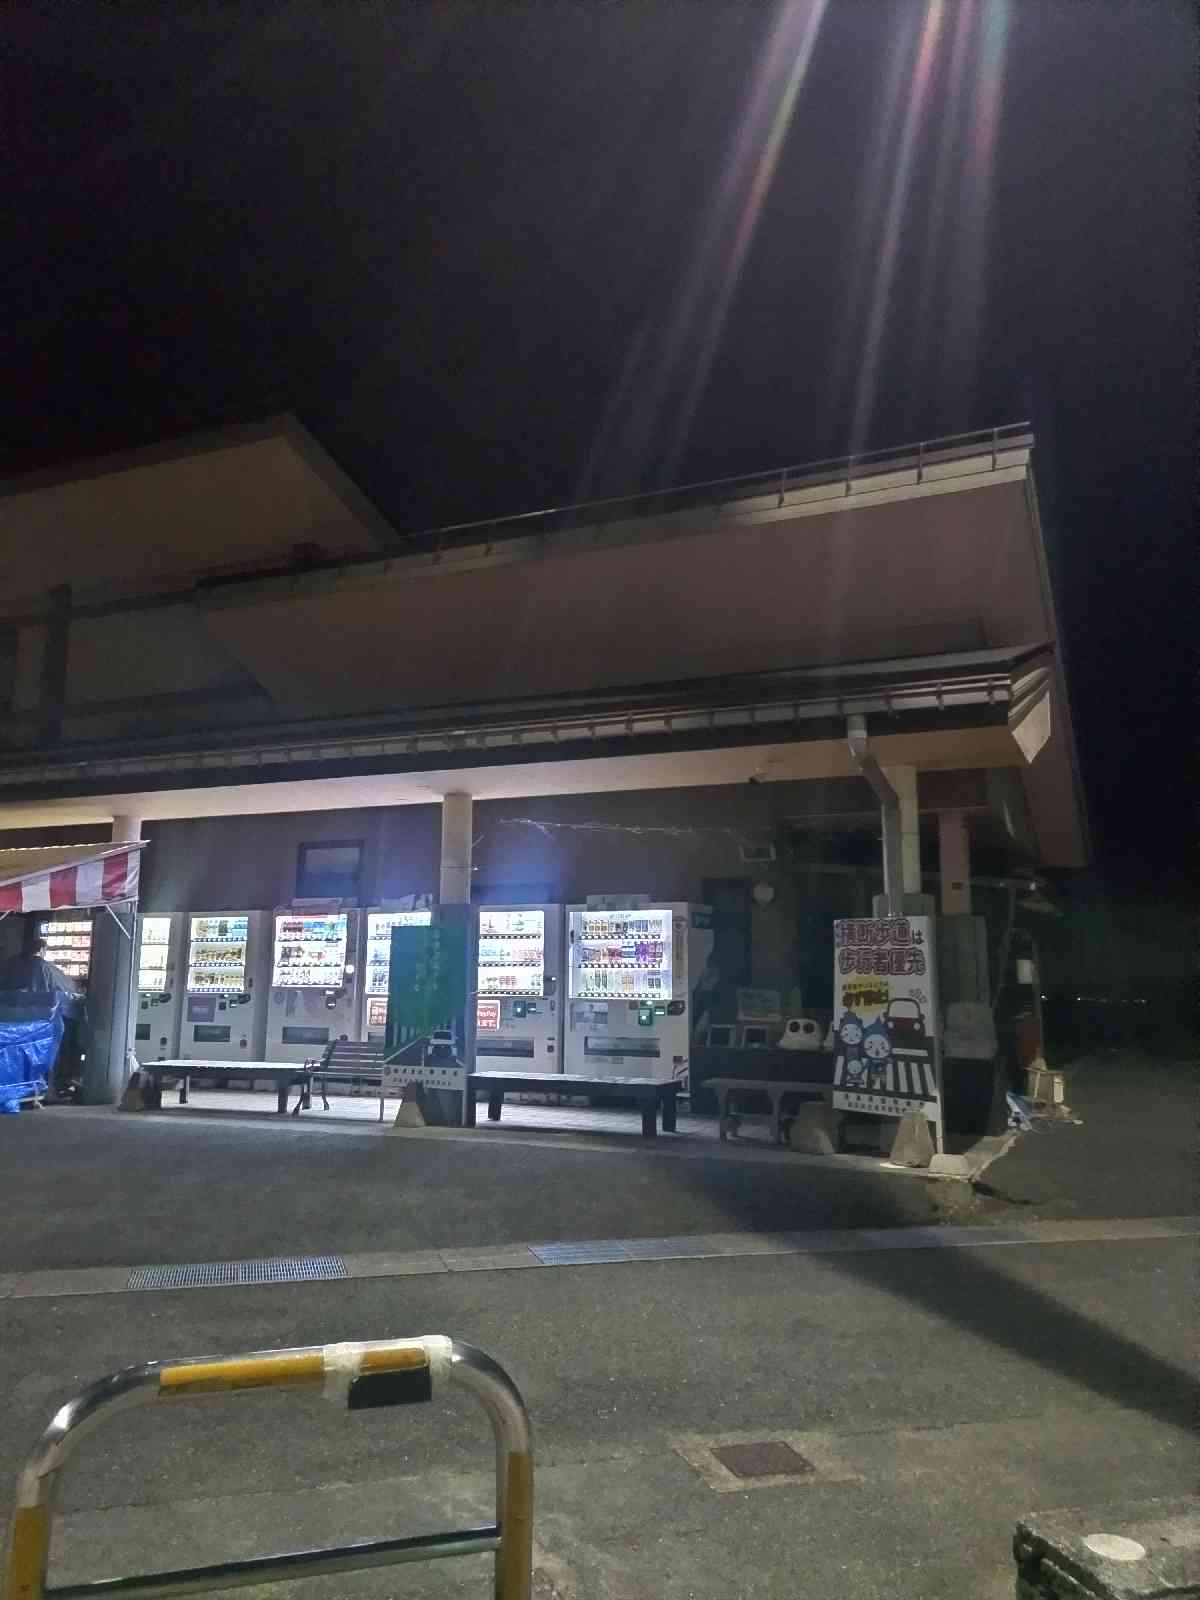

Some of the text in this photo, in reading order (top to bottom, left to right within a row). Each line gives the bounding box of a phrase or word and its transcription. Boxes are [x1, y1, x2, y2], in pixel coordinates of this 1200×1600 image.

[839, 918, 924, 946] 横断歩道は
[839, 947, 926, 976] 歩行者優先
